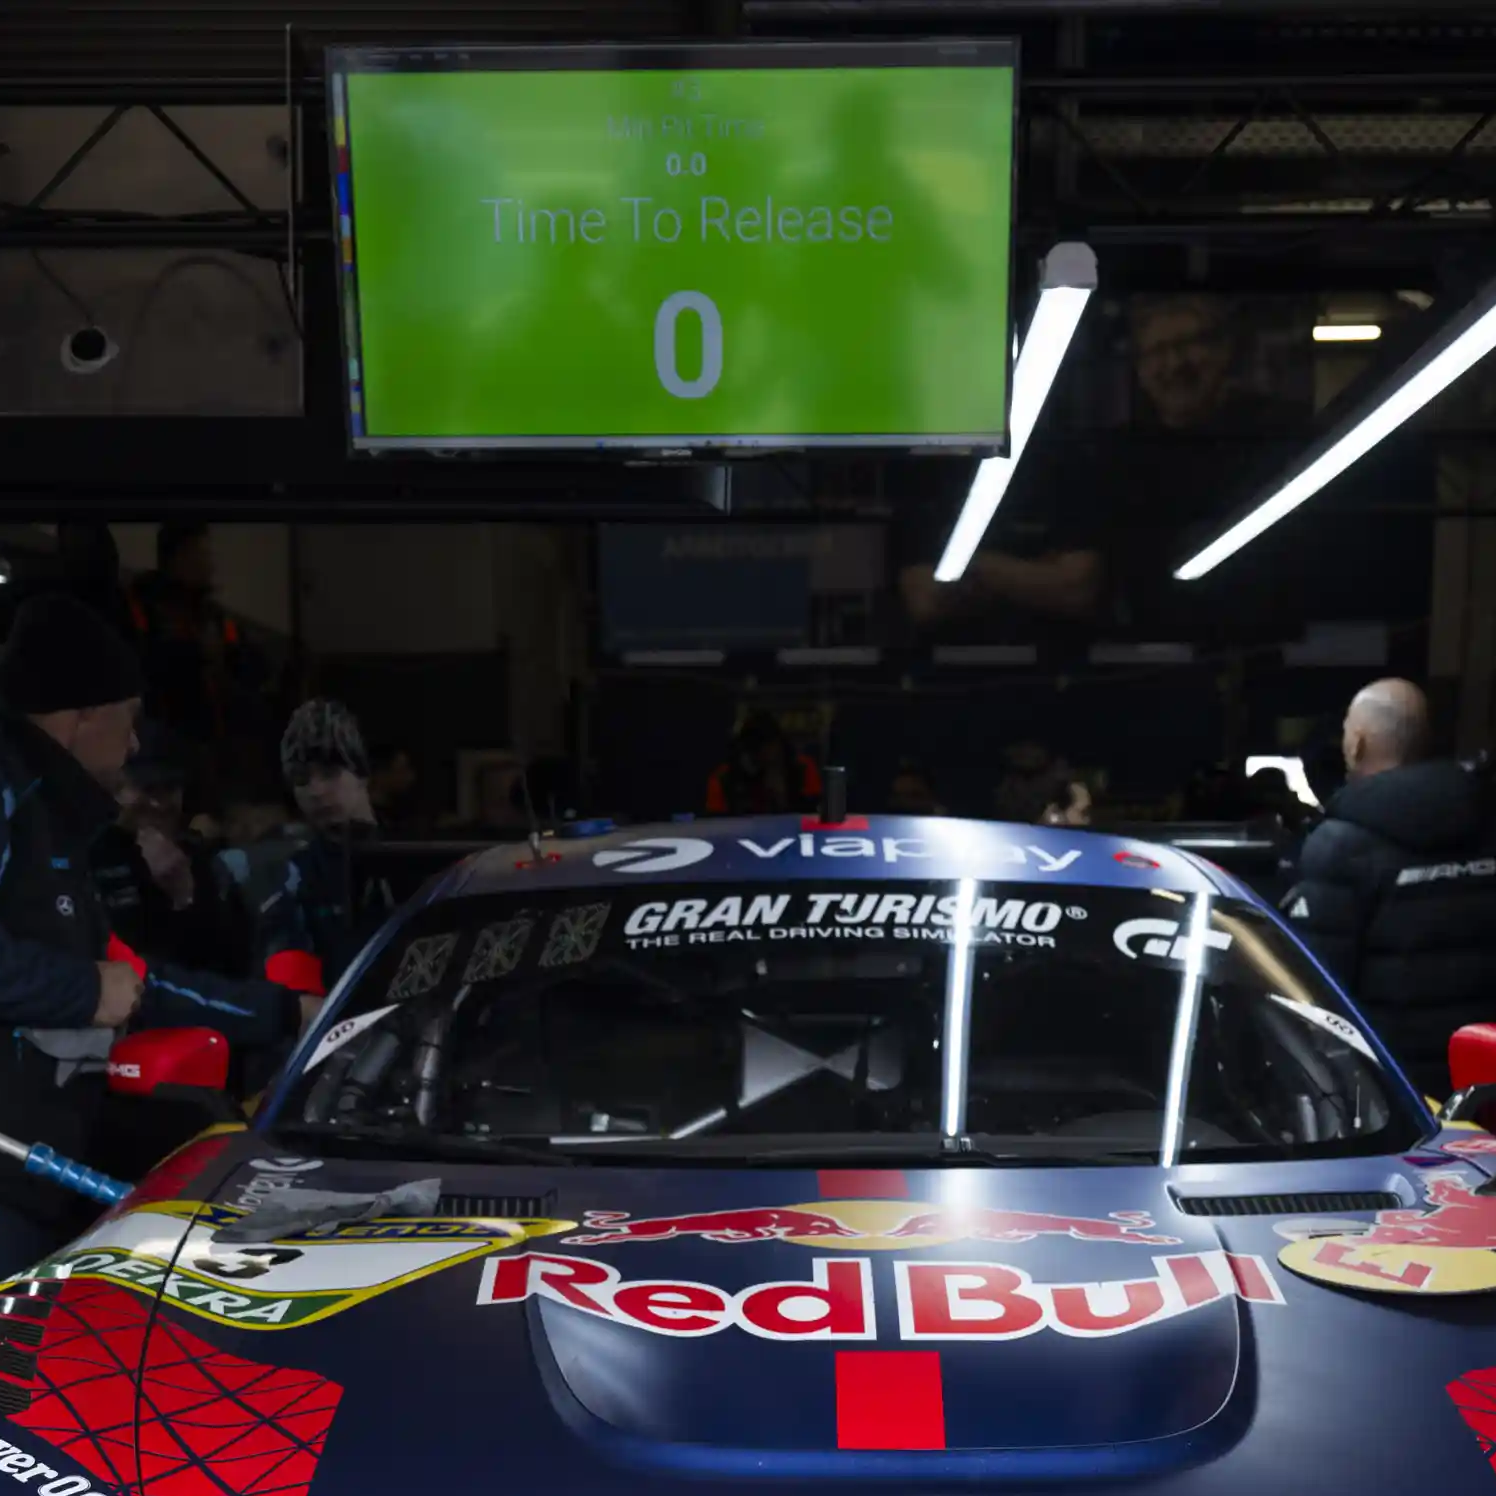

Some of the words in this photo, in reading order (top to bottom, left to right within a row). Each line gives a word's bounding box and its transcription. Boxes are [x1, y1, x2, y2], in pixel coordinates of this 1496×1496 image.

[606, 113, 655, 140] Min
[660, 112, 695, 139] Pit
[702, 112, 765, 139] Time
[665, 151, 708, 177] 0.0
[480, 195, 608, 245] Time
[619, 194, 683, 245] To
[699, 192, 894, 246] Release
[653, 288, 724, 400] 0
[737, 833, 1083, 873] viapay
[623, 893, 776, 937] GRAN
[623, 934, 685, 951] THE
[688, 930, 762, 946] REAL
[767, 925, 884, 942] DRIVING
[65, 1253, 294, 1325] DEKRA
[476, 1252, 877, 1341] Red
[893, 1251, 1289, 1341] Bull
